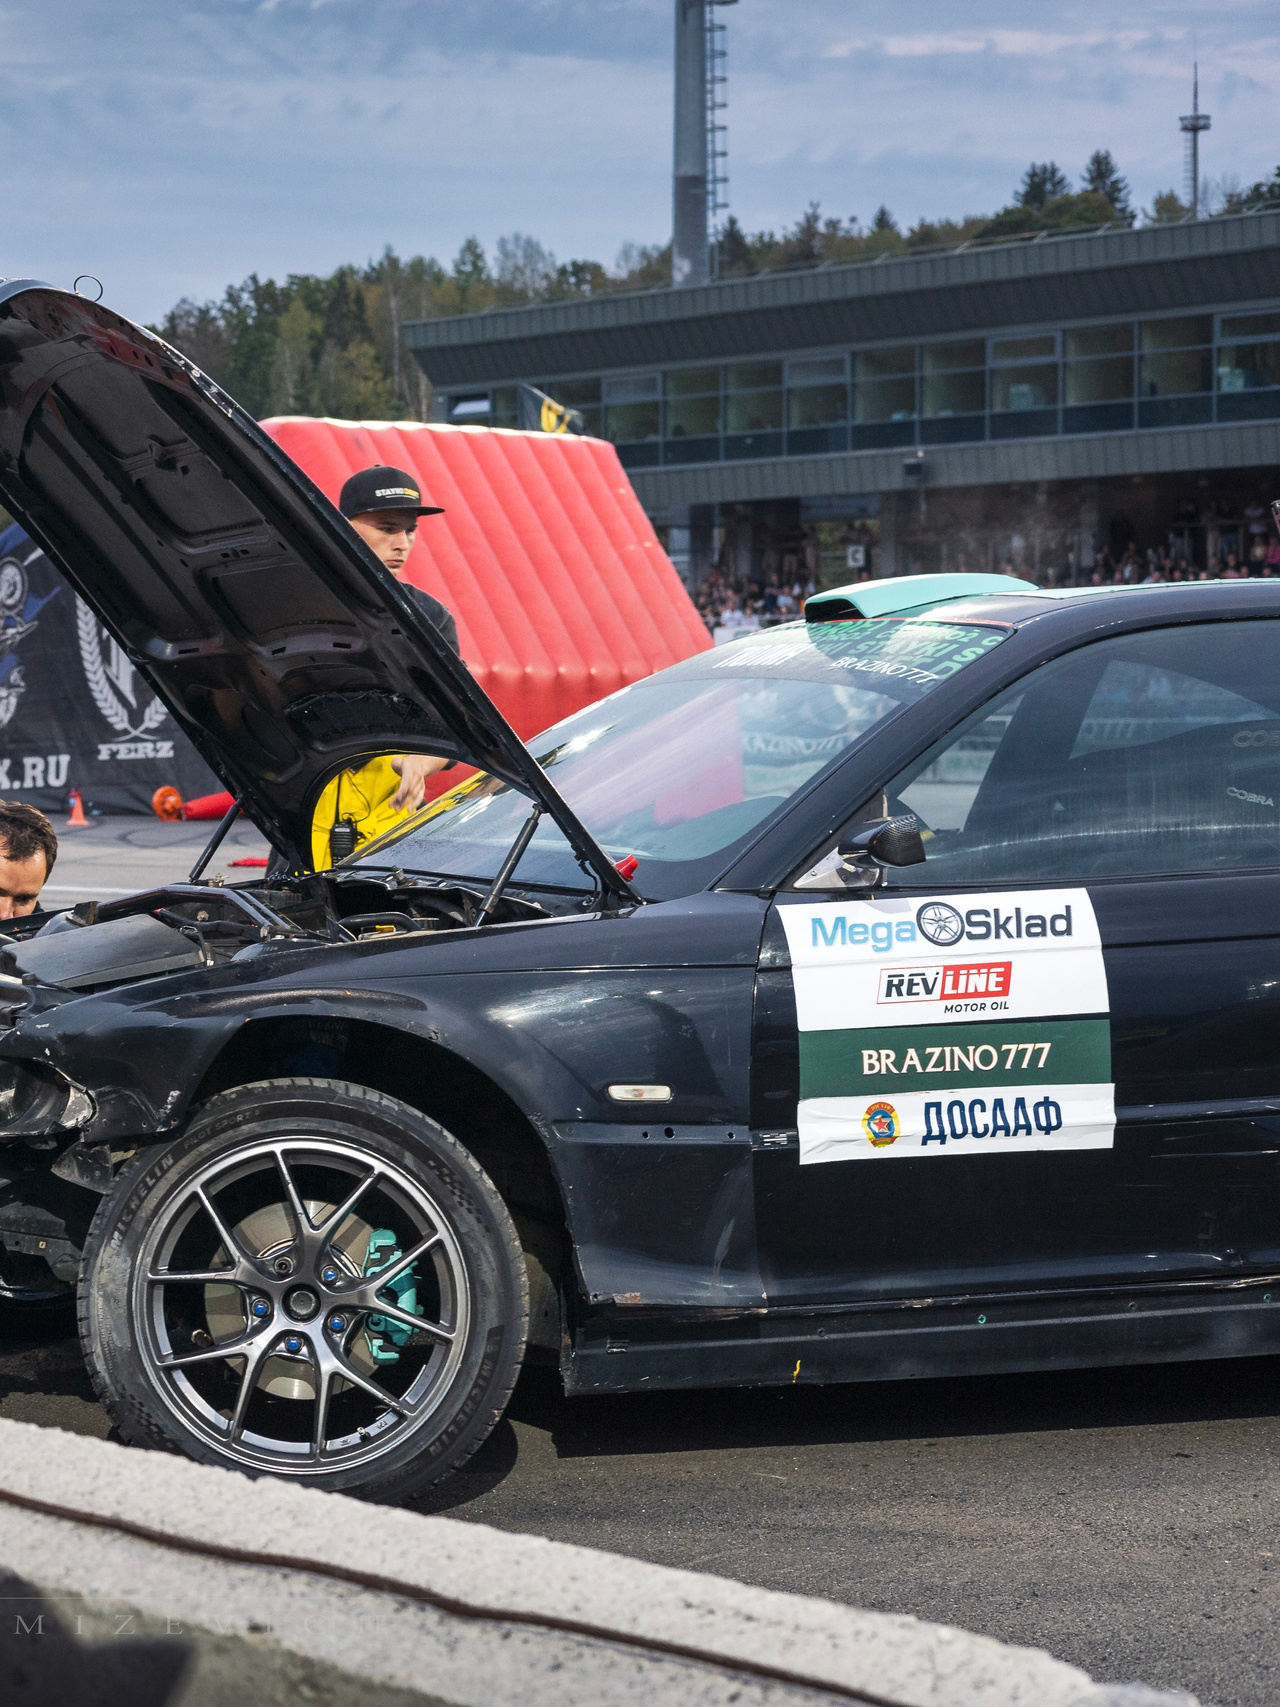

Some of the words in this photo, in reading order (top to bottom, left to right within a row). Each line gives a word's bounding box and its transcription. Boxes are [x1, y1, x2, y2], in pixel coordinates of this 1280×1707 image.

[97, 741, 175, 761] FERZ
[1226, 786, 1275, 807] COBRA
[944, 1002, 986, 1013] MOTOR
[990, 1001, 1009, 1010] OIL
[921, 1096, 1063, 1146] ДОСААФ
[110, 1154, 174, 1249] MICHELIN
